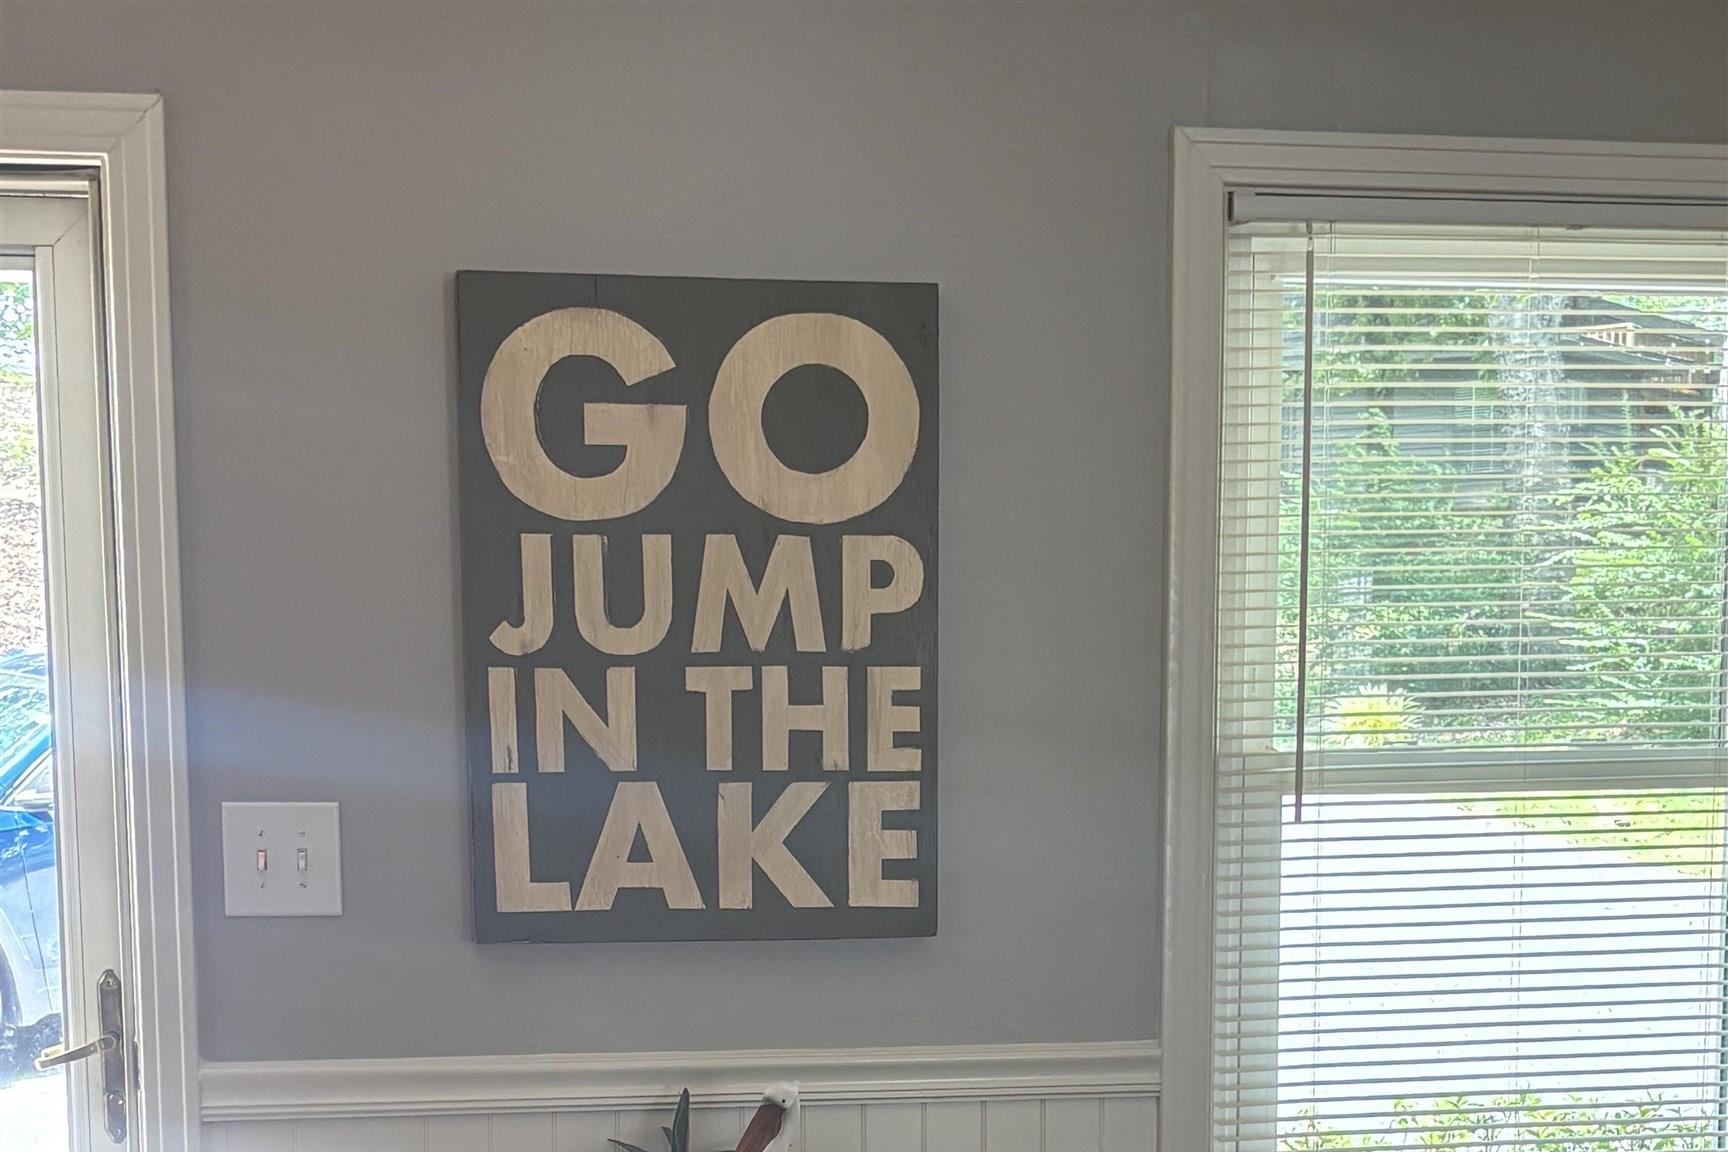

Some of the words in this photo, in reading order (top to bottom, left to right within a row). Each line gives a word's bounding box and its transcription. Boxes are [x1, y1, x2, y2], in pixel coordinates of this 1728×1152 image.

[480, 307, 920, 524] GO
[488, 533, 925, 656] JUMP
[488, 667, 638, 774] IN
[685, 666, 922, 772] THE
[492, 781, 921, 913] LAKE
